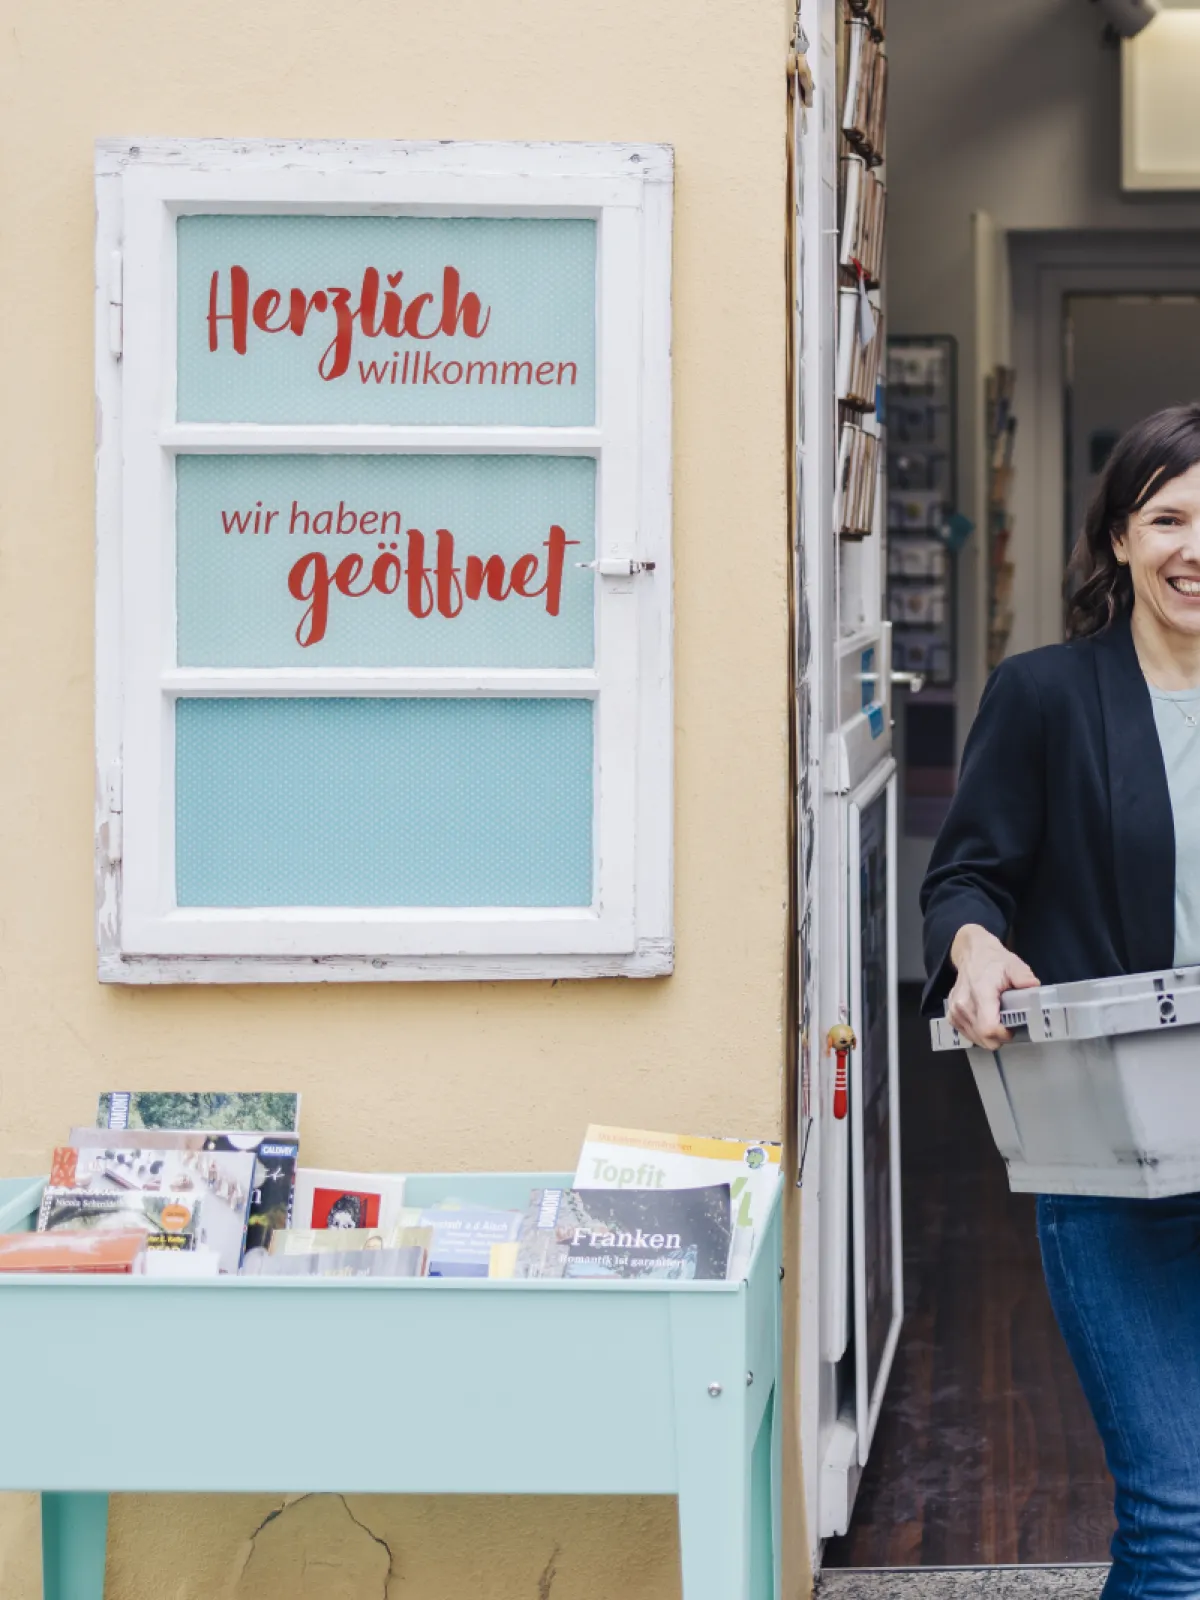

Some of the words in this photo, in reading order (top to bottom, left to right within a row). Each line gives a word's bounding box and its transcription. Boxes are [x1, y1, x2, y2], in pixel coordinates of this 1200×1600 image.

[207, 265, 491, 382] Herzlich
[358, 351, 578, 386] willkommen
[221, 501, 280, 536] wir
[289, 500, 402, 536] haben
[288, 524, 581, 648] geöffnet
[590, 1157, 667, 1188] Topfit
[571, 1227, 682, 1249] Franken
[560, 1253, 613, 1266] Romantik
